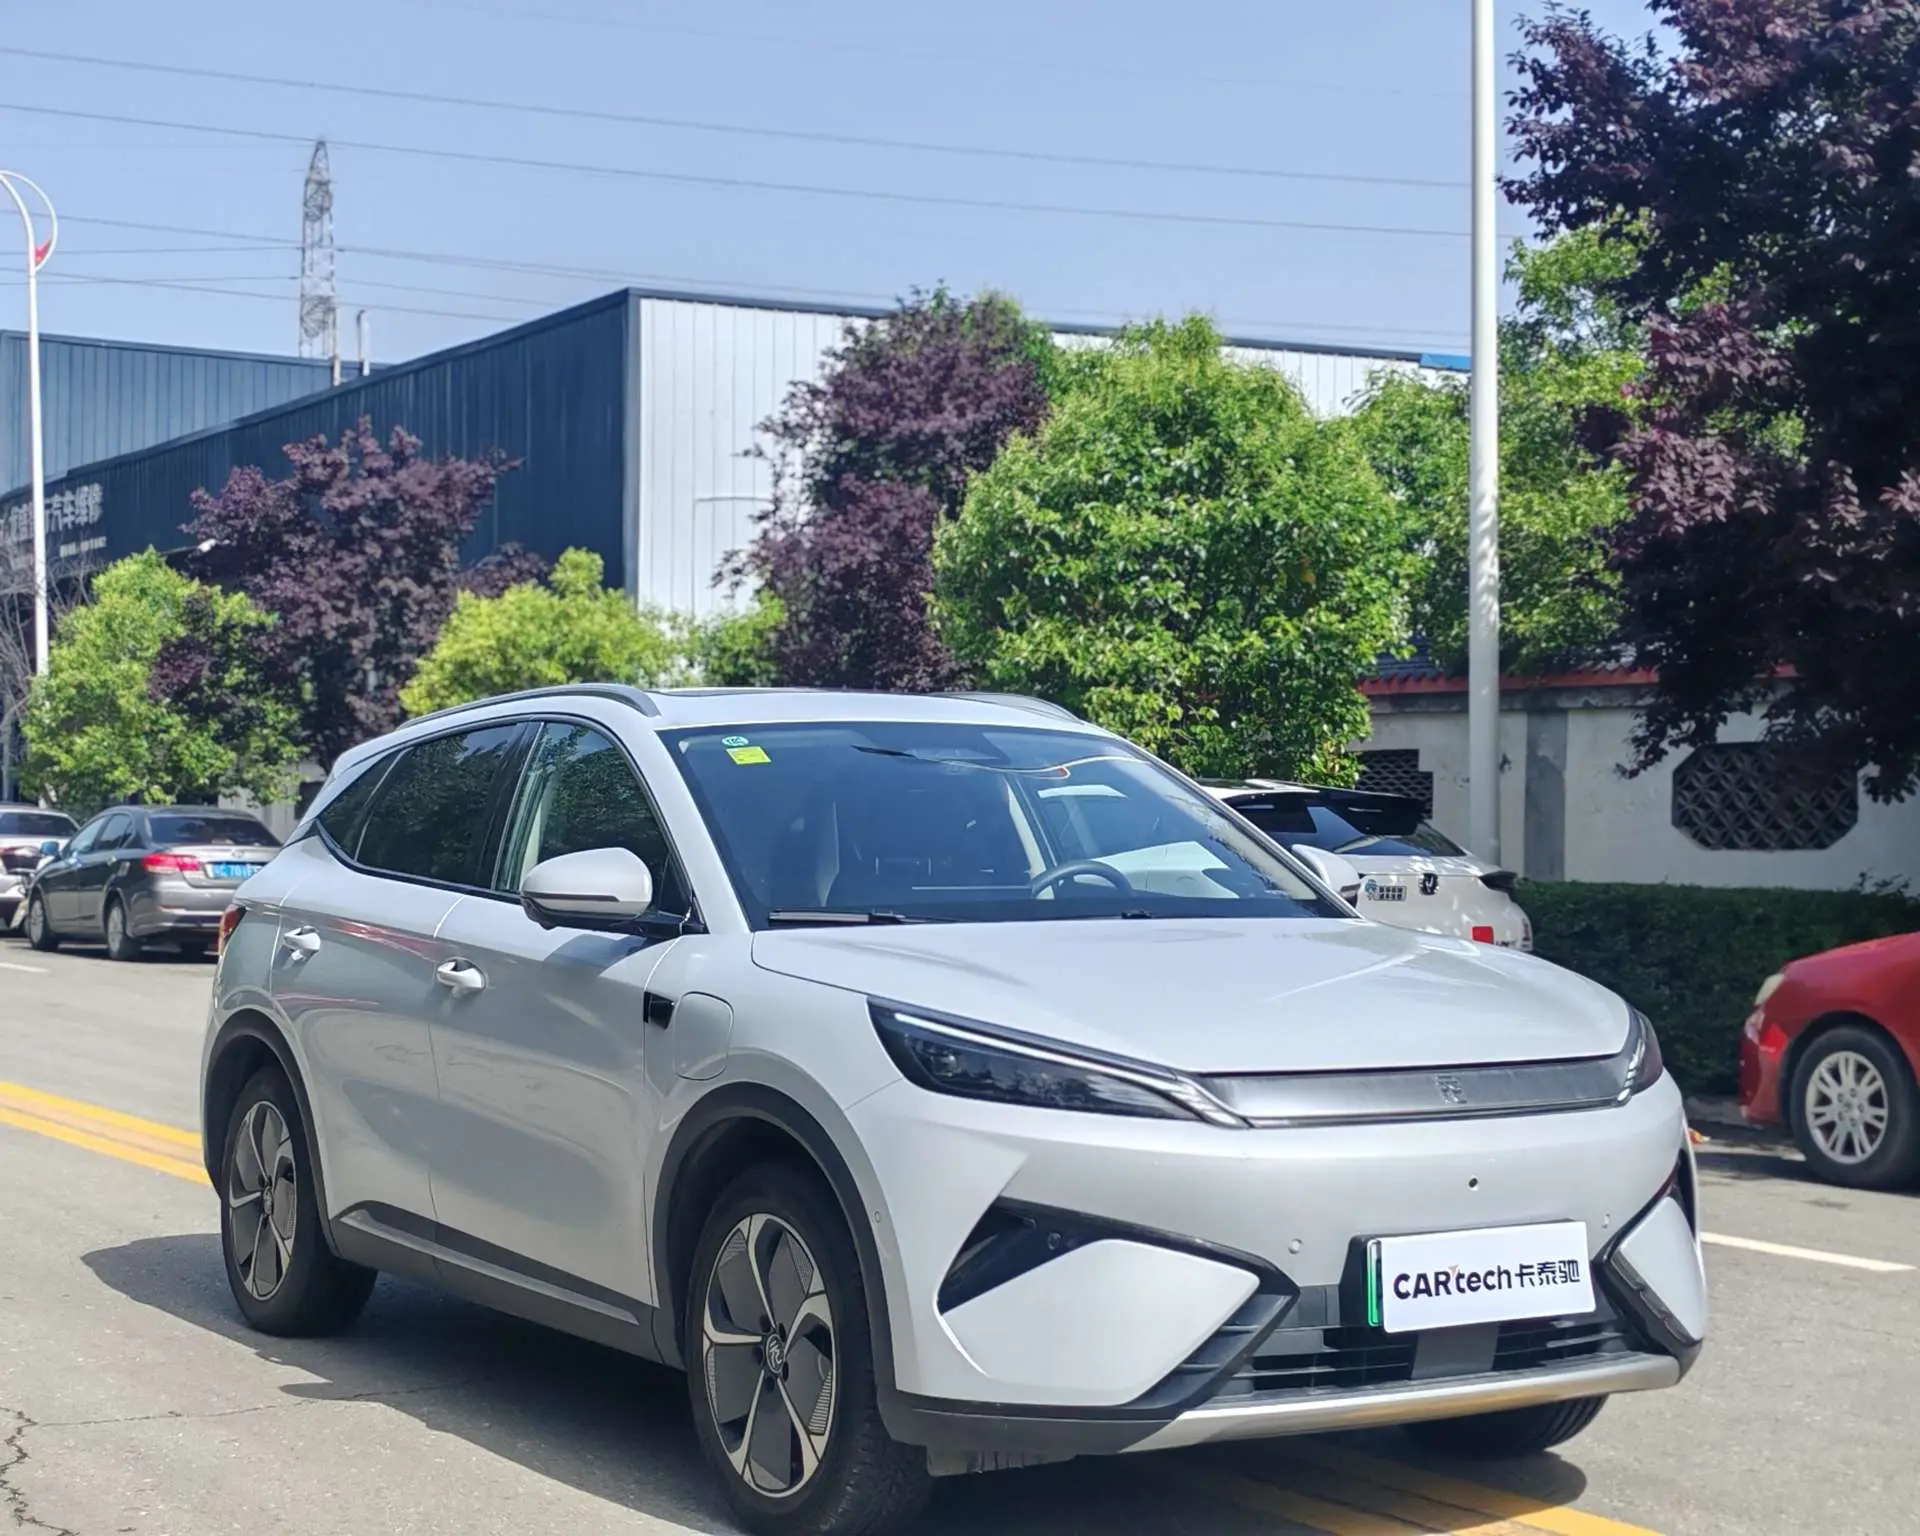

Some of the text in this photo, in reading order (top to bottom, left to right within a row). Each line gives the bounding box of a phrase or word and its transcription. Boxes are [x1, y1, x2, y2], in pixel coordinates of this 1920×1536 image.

[1394, 1259, 1581, 1300] CARtech 卡泰驰
